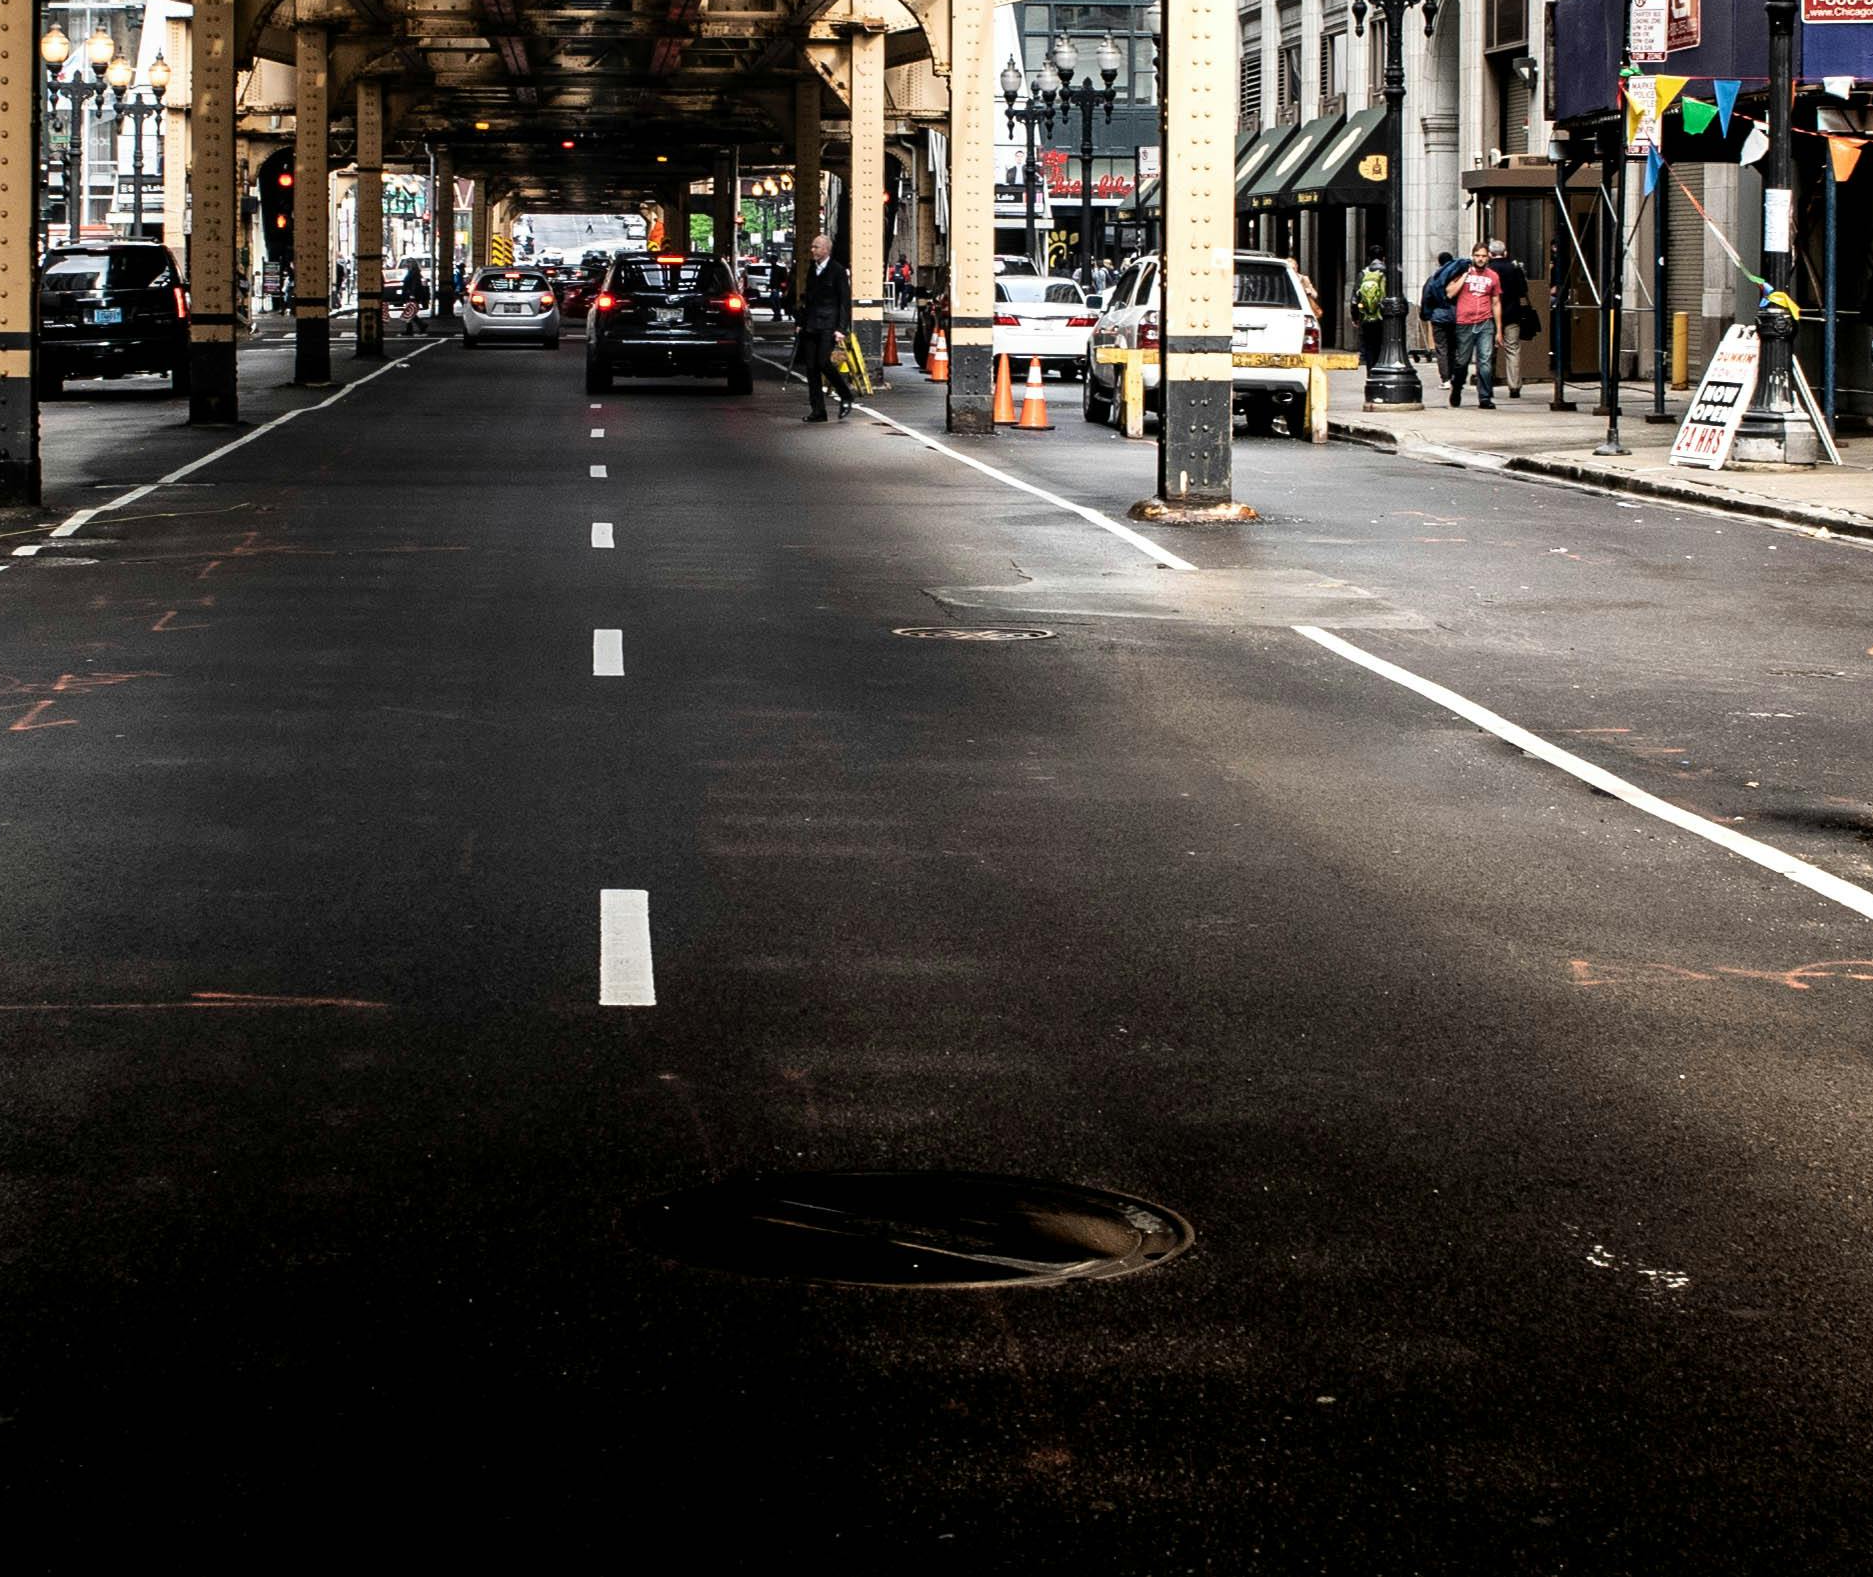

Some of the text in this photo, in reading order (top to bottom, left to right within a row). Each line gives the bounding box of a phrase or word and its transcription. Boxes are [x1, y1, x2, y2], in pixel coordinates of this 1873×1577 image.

[1701, 384, 1740, 403] NOW
[1691, 403, 1735, 423] OPEN
[1676, 425, 1725, 455] 24 HRS
